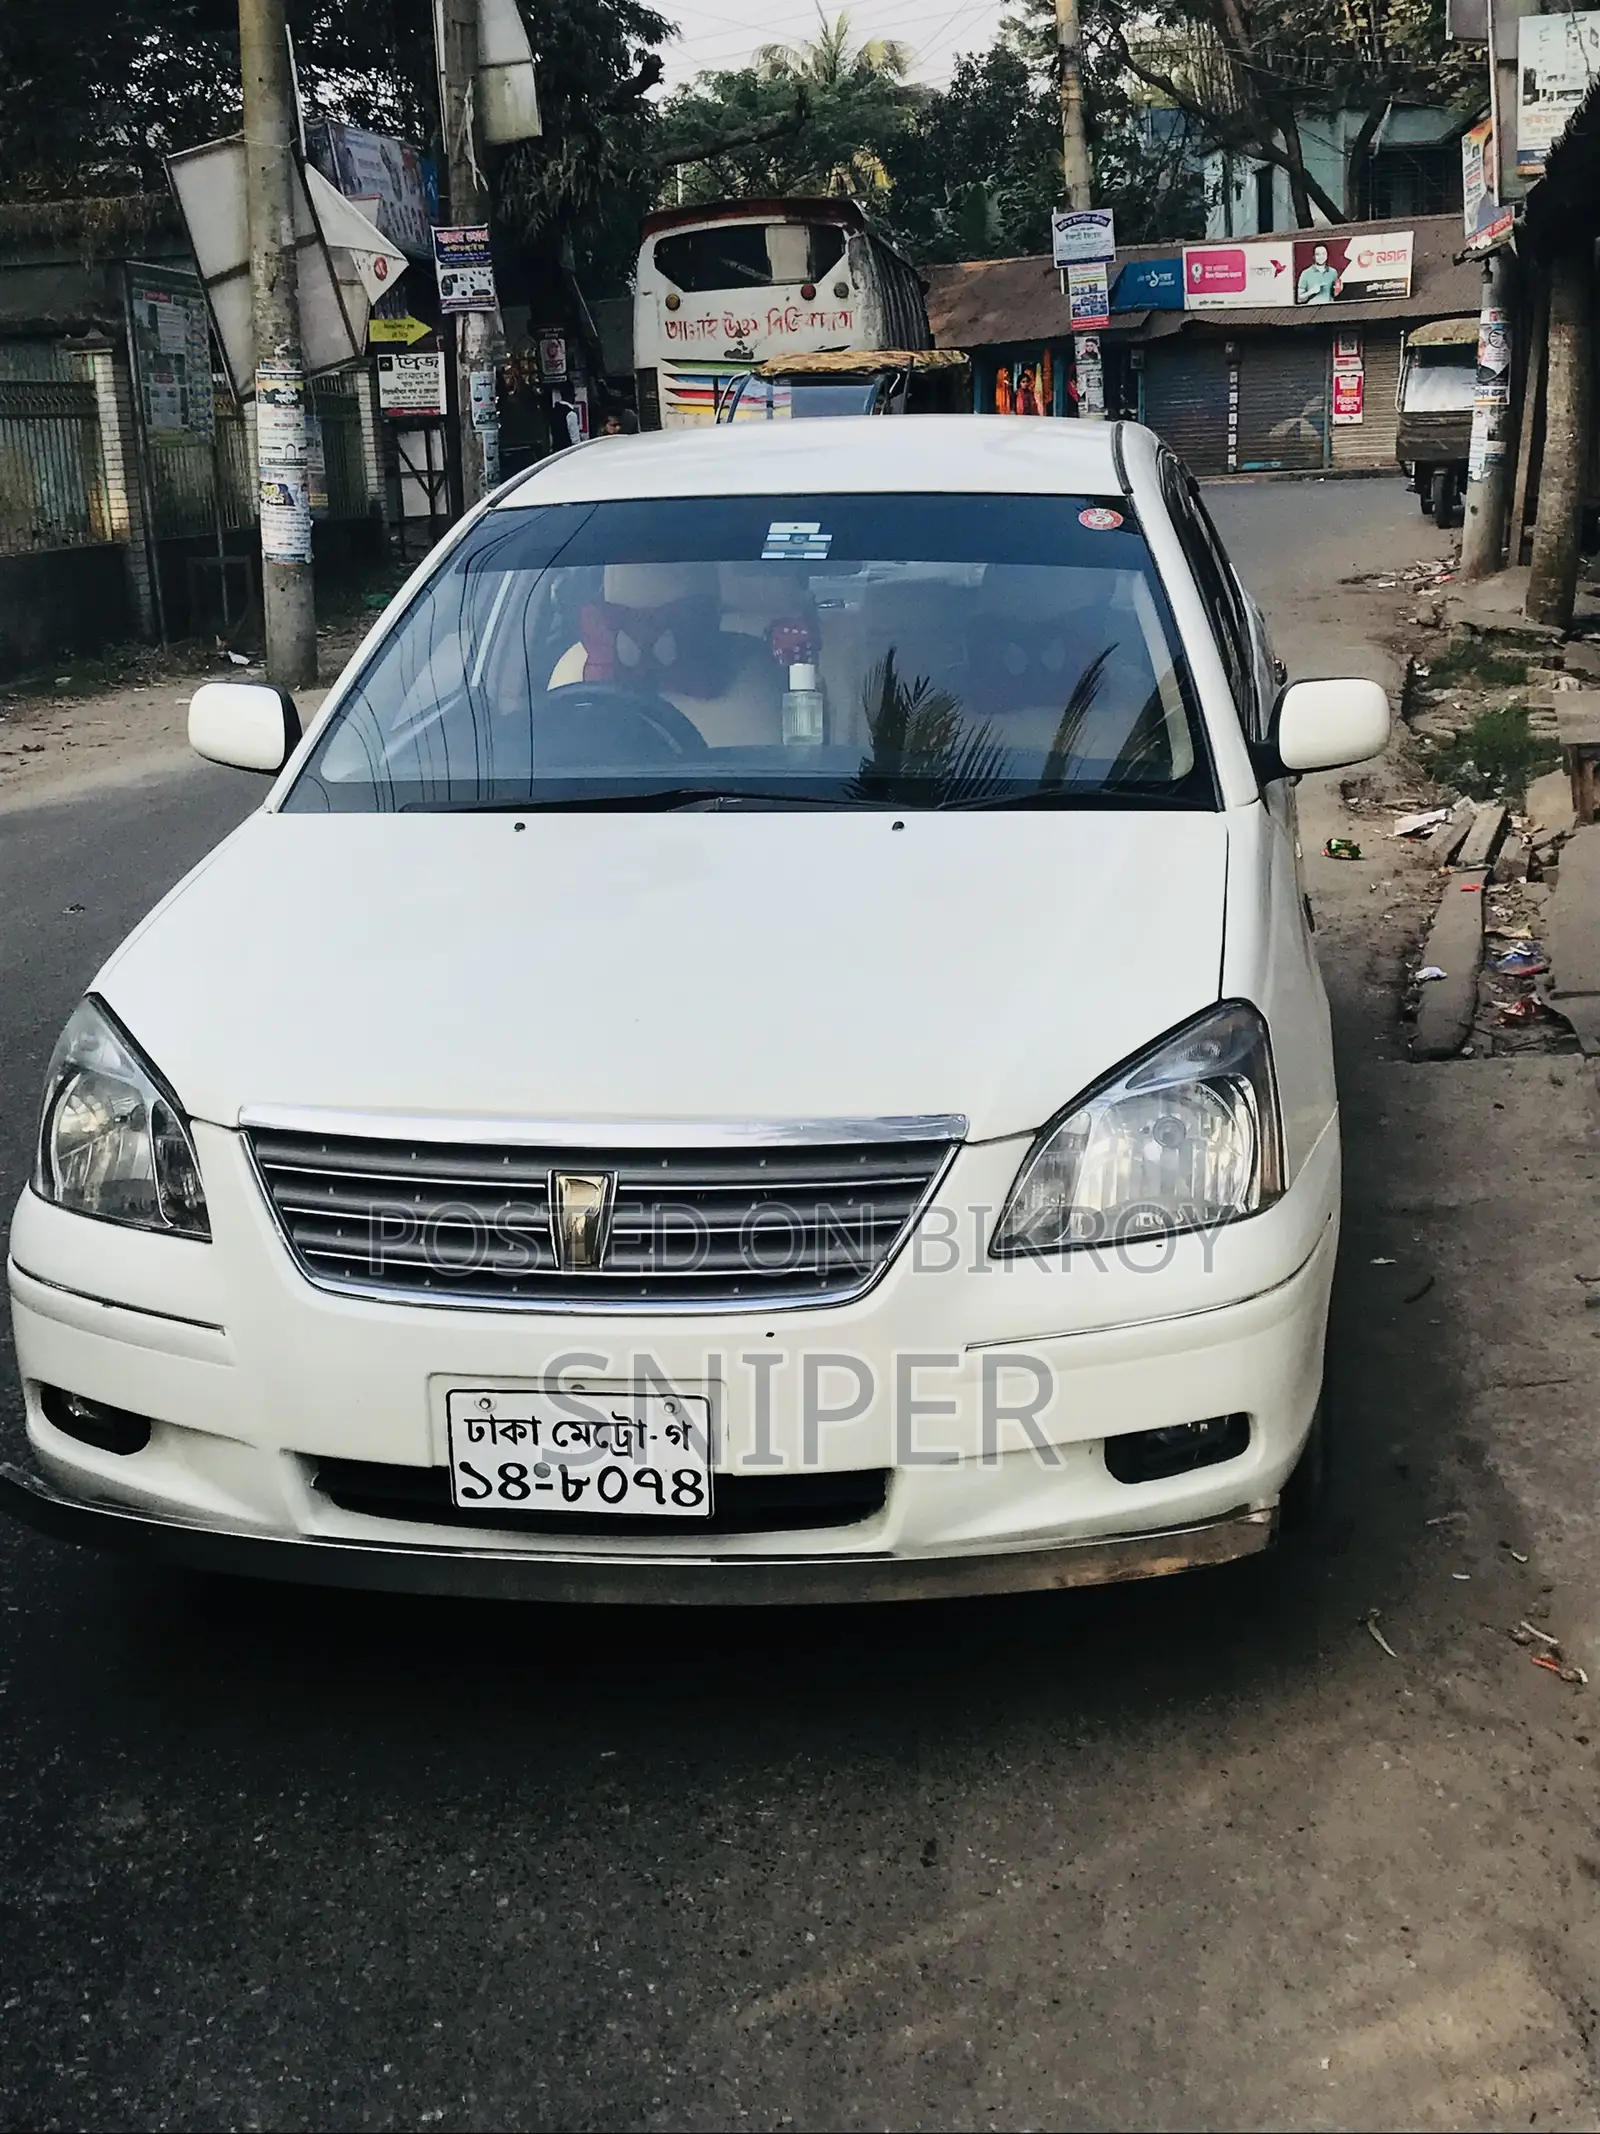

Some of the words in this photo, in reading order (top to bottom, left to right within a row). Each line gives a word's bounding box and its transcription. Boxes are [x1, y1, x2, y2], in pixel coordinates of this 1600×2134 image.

[1376, 249, 1407, 263] নগদ
[464, 1414, 541, 1446] ঢাকা
[458, 1461, 705, 1507] ১৪-৮০৭৪
